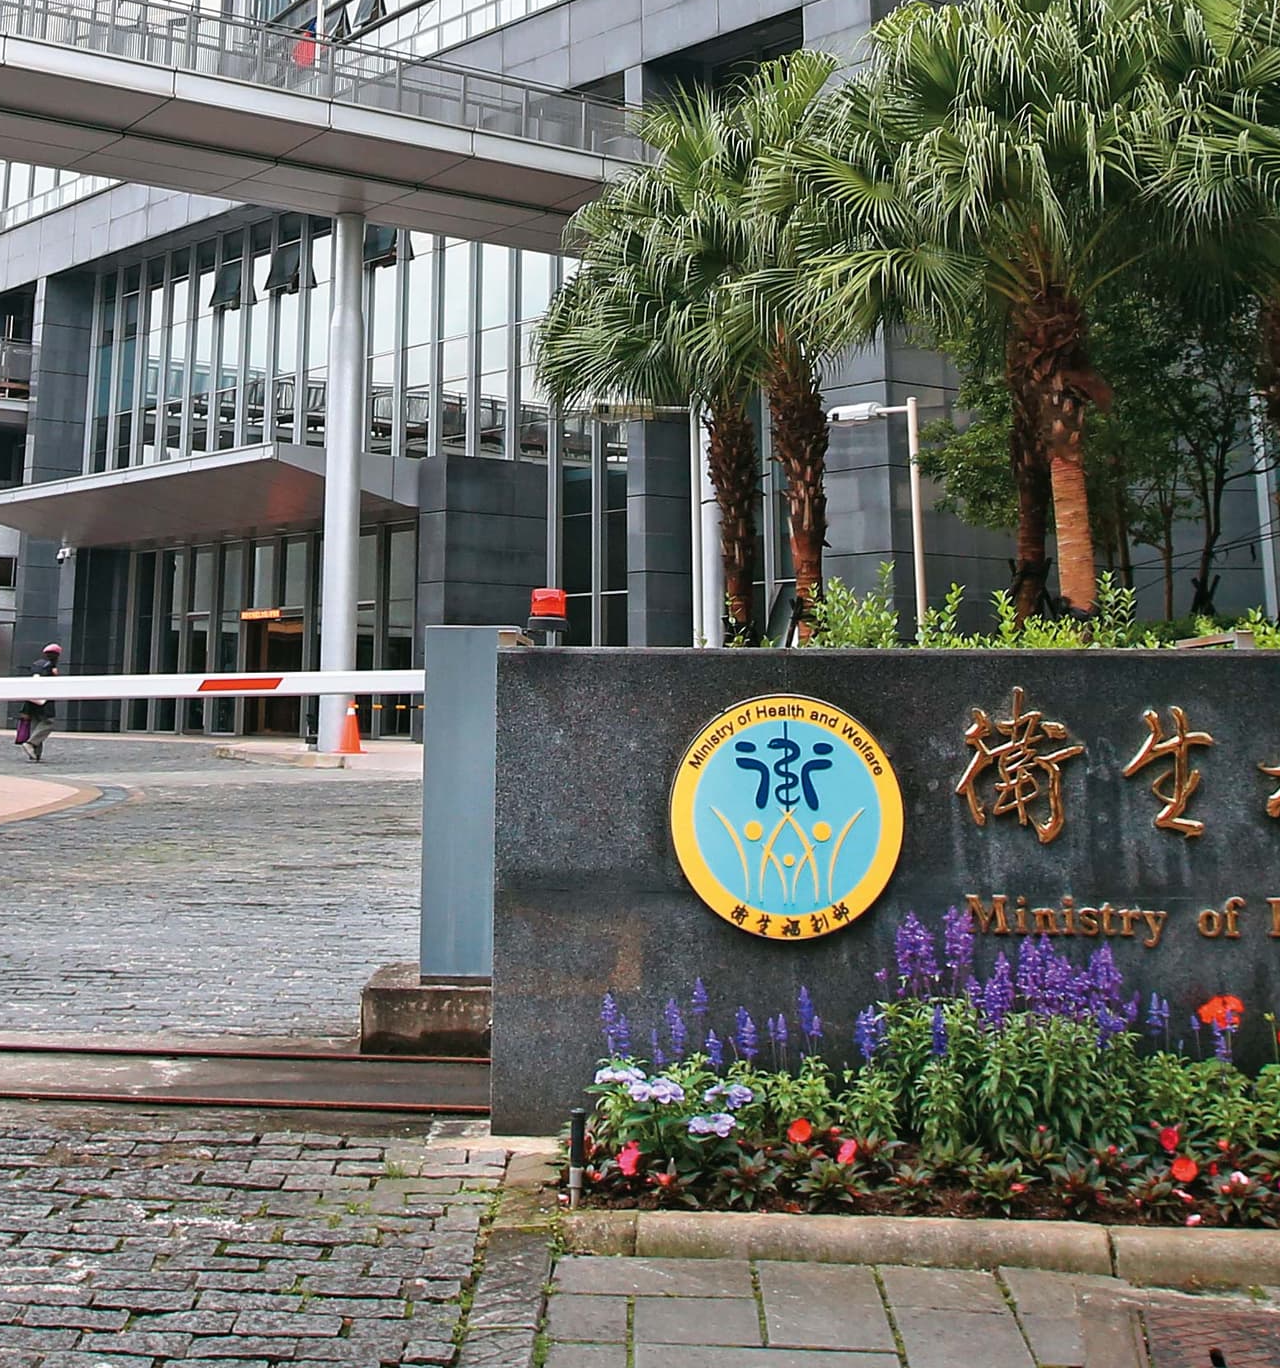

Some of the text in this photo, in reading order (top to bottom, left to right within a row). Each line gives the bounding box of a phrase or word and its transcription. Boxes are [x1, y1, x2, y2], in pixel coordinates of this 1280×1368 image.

[688, 704, 884, 777] Ministry of Health and Welfare
[964, 893, 1168, 948] Ministry
[1197, 896, 1246, 939] of
